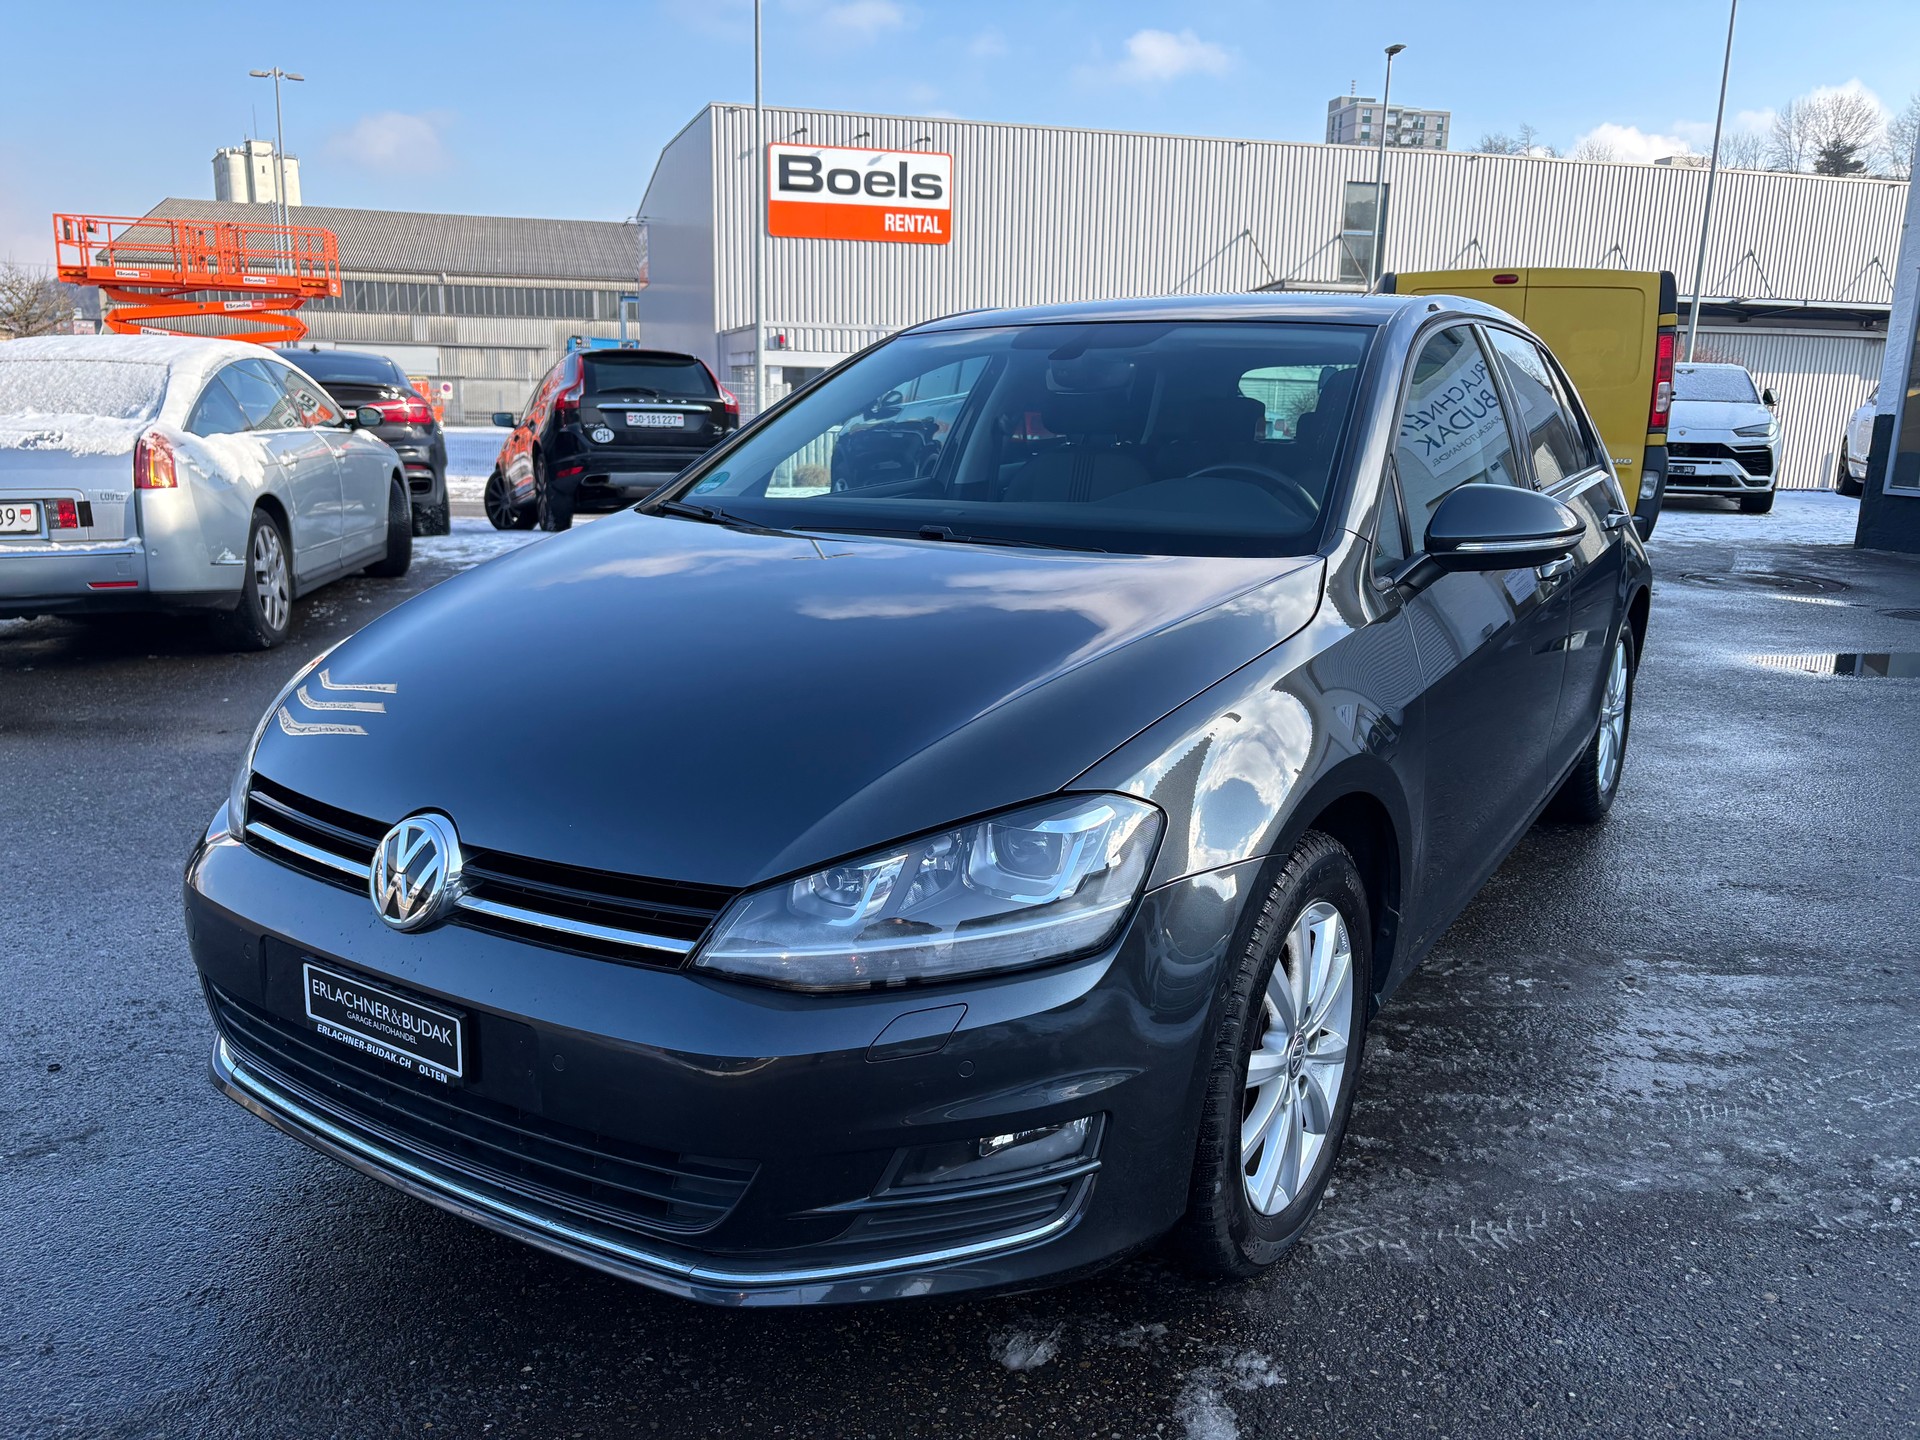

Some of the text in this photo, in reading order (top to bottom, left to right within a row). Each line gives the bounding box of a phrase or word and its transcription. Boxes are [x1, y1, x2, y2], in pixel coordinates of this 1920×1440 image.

[778, 154, 943, 200] Boels
[885, 213, 943, 234] RENTAL
[595, 430, 611, 442] CH
[312, 978, 453, 1047] ERLACHNER&BUDAK
[346, 1010, 418, 1045] GARAGE AUTOHANDEL
[316, 1023, 448, 1084] ERLACHNER-BUDAK.CH OLTEN
